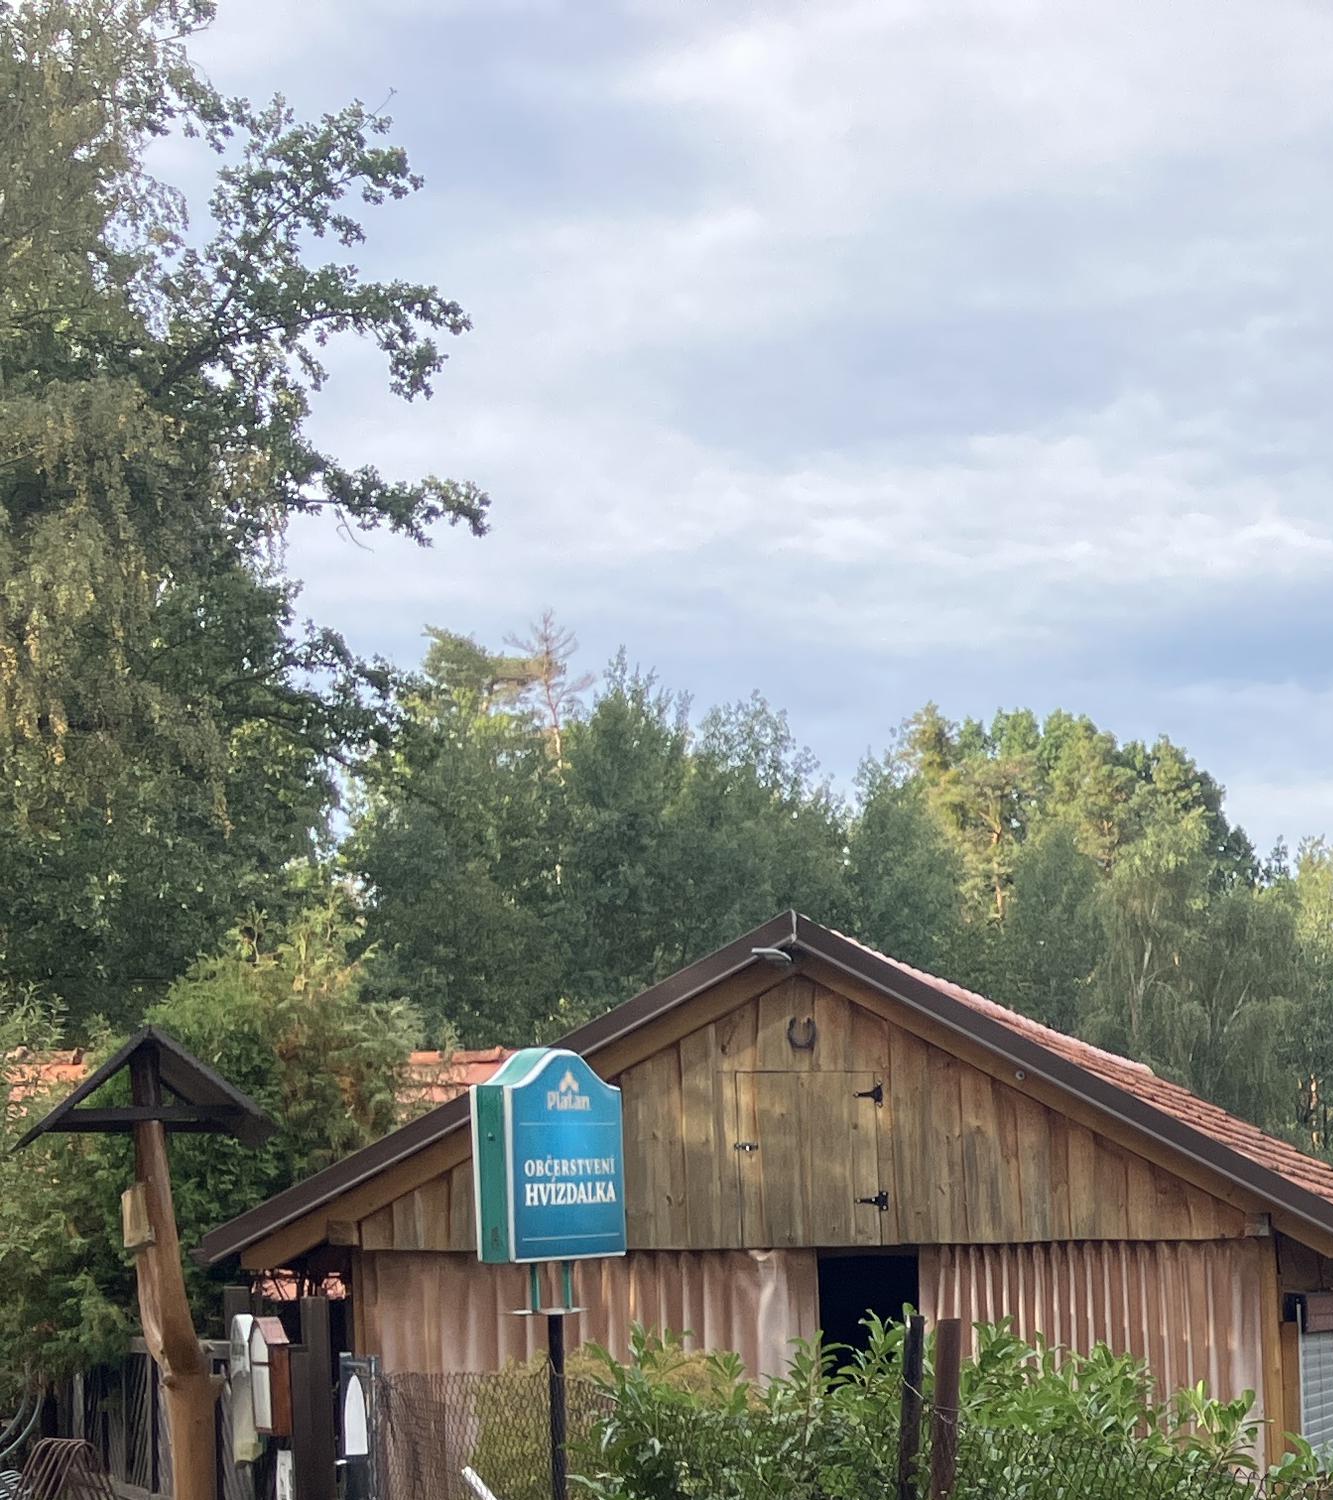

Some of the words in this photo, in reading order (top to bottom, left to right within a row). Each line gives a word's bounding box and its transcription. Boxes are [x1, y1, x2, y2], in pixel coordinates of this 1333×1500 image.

[547, 1091, 592, 1111] Platan
[524, 1153, 616, 1176] OBČERSTVENÍ
[525, 1176, 616, 1206] HVÍZDALKA
